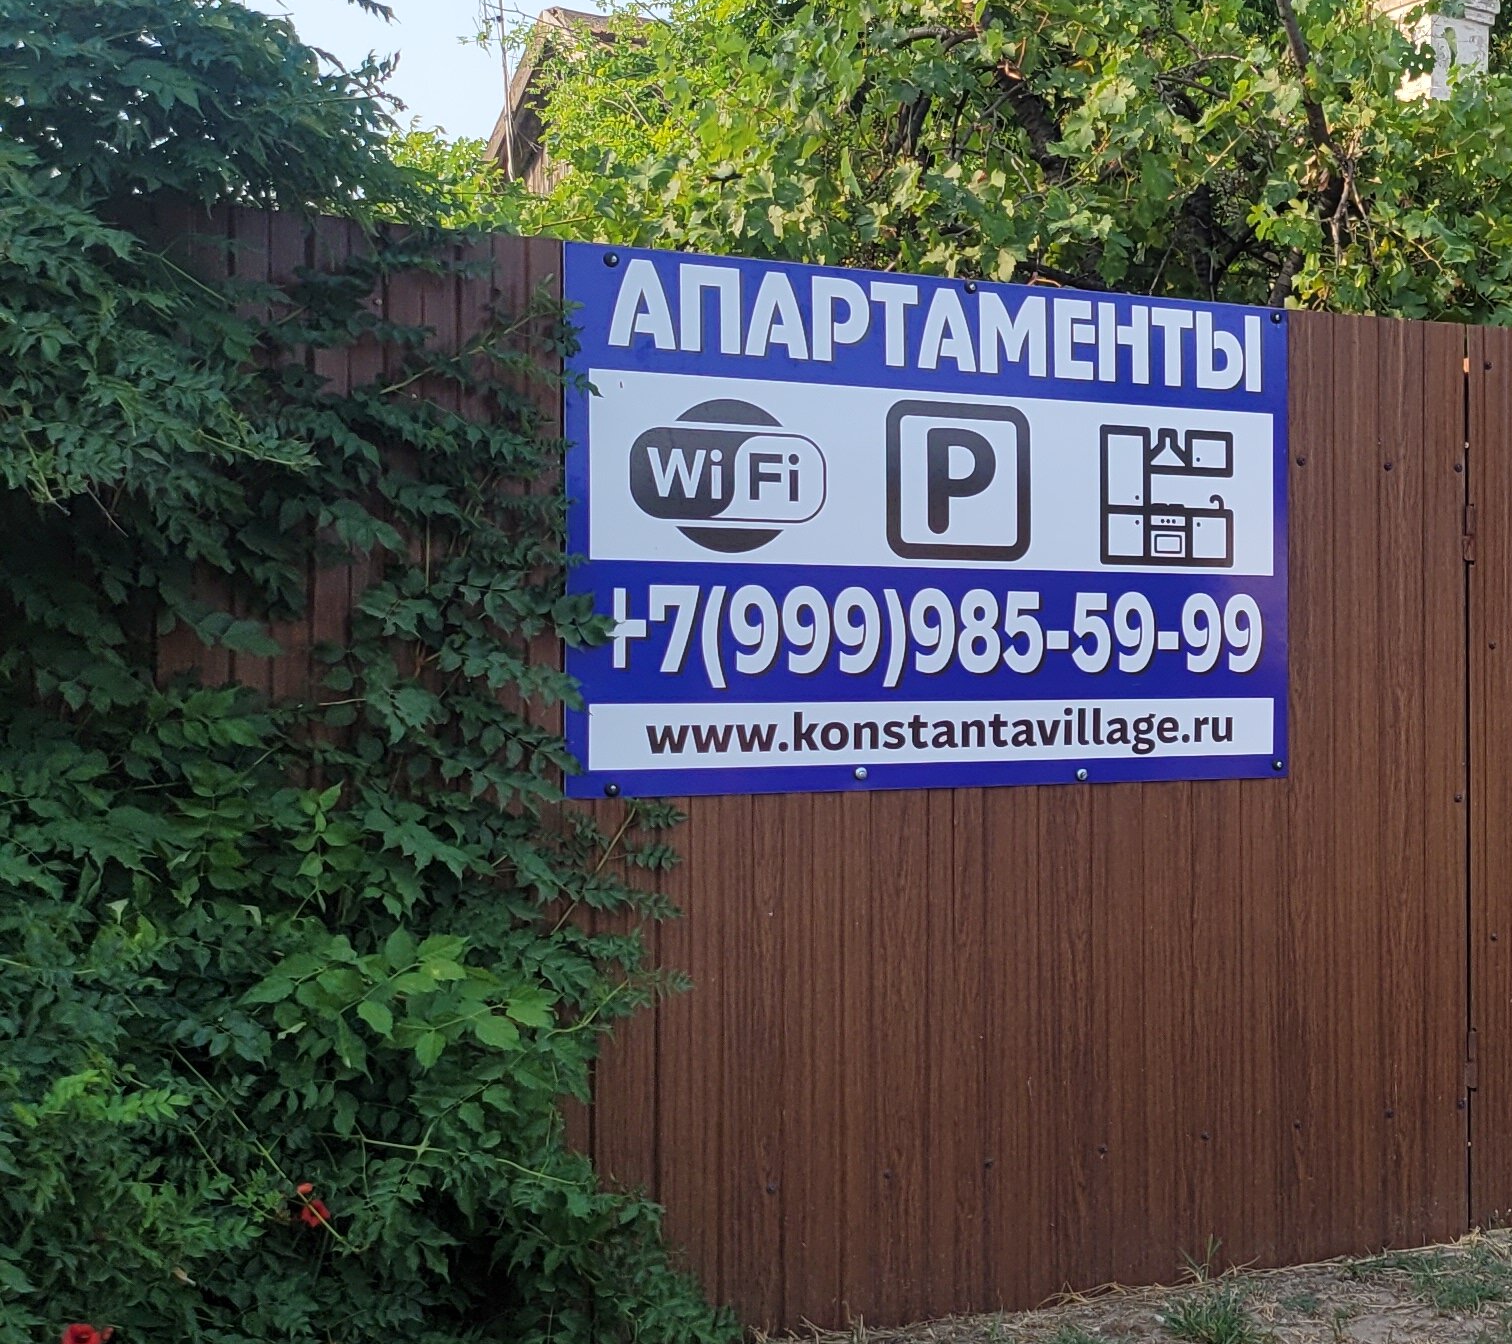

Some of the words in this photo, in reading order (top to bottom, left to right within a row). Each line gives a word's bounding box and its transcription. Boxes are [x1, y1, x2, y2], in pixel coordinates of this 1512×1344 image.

[607, 259, 1263, 393] АПАРТАМЕНТЫ
[604, 584, 1264, 690] +7(999)985-59-99
[645, 708, 1235, 756] www.konstantavillage.ru
